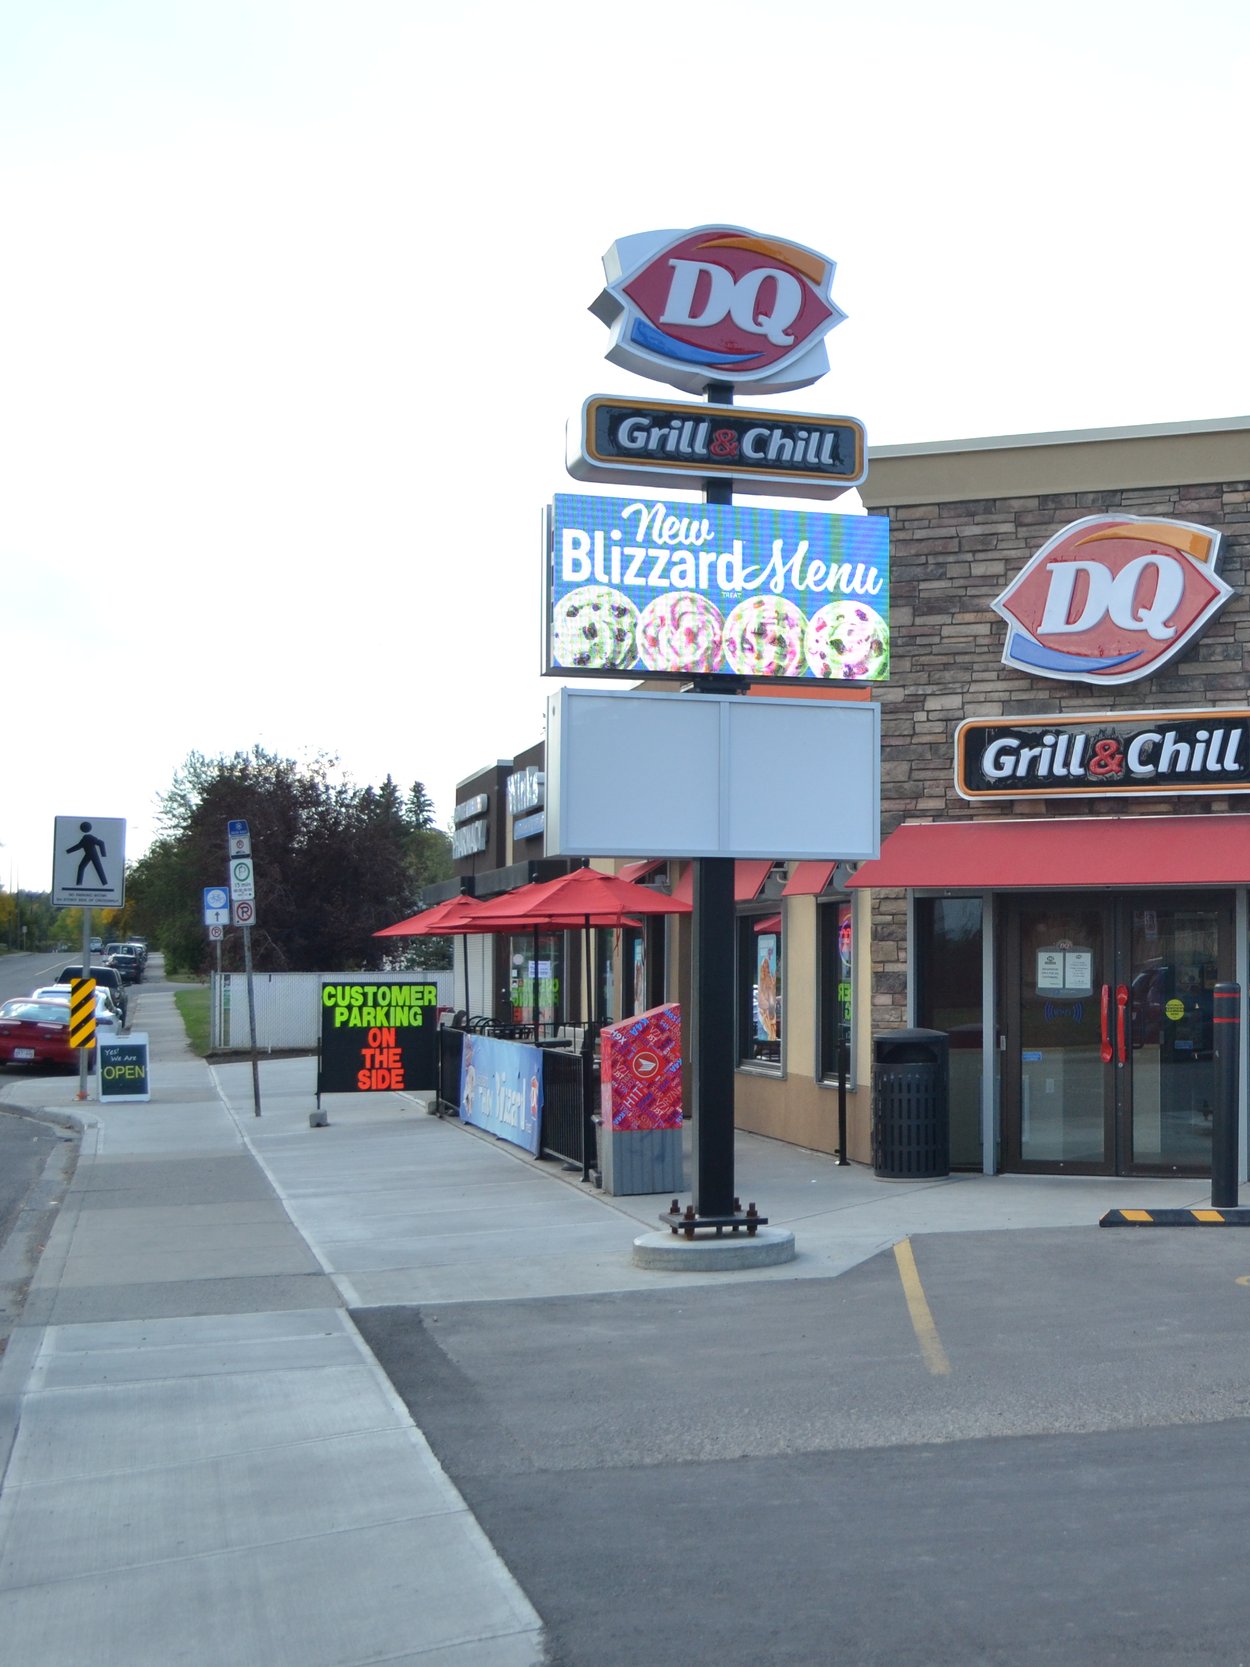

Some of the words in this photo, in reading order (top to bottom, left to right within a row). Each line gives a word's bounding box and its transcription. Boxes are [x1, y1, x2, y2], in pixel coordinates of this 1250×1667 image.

[660, 258, 804, 346] DQ
[618, 417, 707, 454] Grill
[742, 428, 838, 465] Chill
[622, 503, 714, 545] New
[562, 528, 742, 590] Blizzard
[740, 539, 884, 595] Menu
[1037, 554, 1186, 640] DQ
[981, 734, 1086, 778] Grill
[1127, 729, 1243, 774] Chill
[323, 986, 437, 1006] CUSTOMER
[335, 1006, 423, 1027] PARKING
[368, 1027, 395, 1047] ON
[104, 1065, 145, 1079] OPEN
[361, 1048, 402, 1068] THE
[358, 1069, 404, 1090] SIDE
